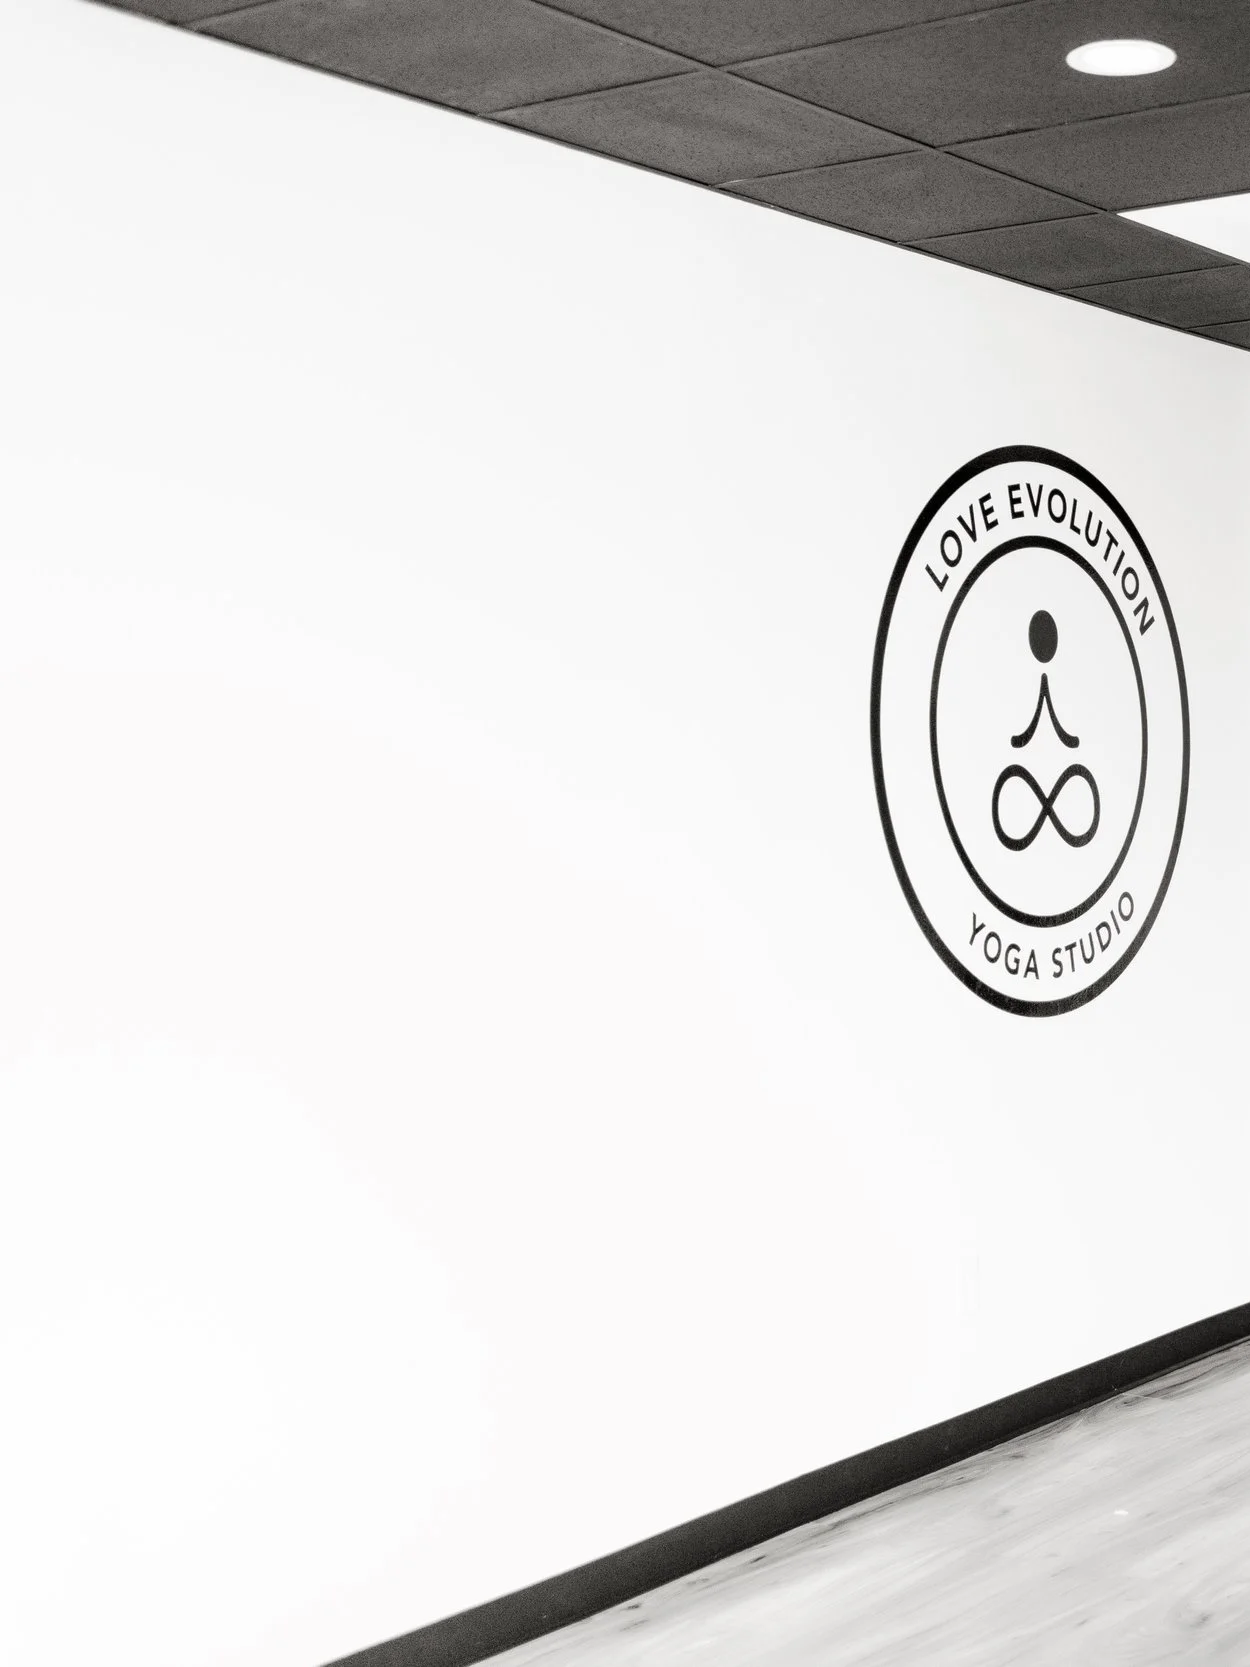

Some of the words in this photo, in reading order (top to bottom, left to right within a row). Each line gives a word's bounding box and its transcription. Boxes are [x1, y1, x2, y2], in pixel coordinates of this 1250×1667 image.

[924, 492, 999, 592] LOVE
[1007, 482, 1155, 636] EVOLUTION
[968, 911, 1040, 981] YOGA
[1051, 891, 1135, 980] STUDIO
